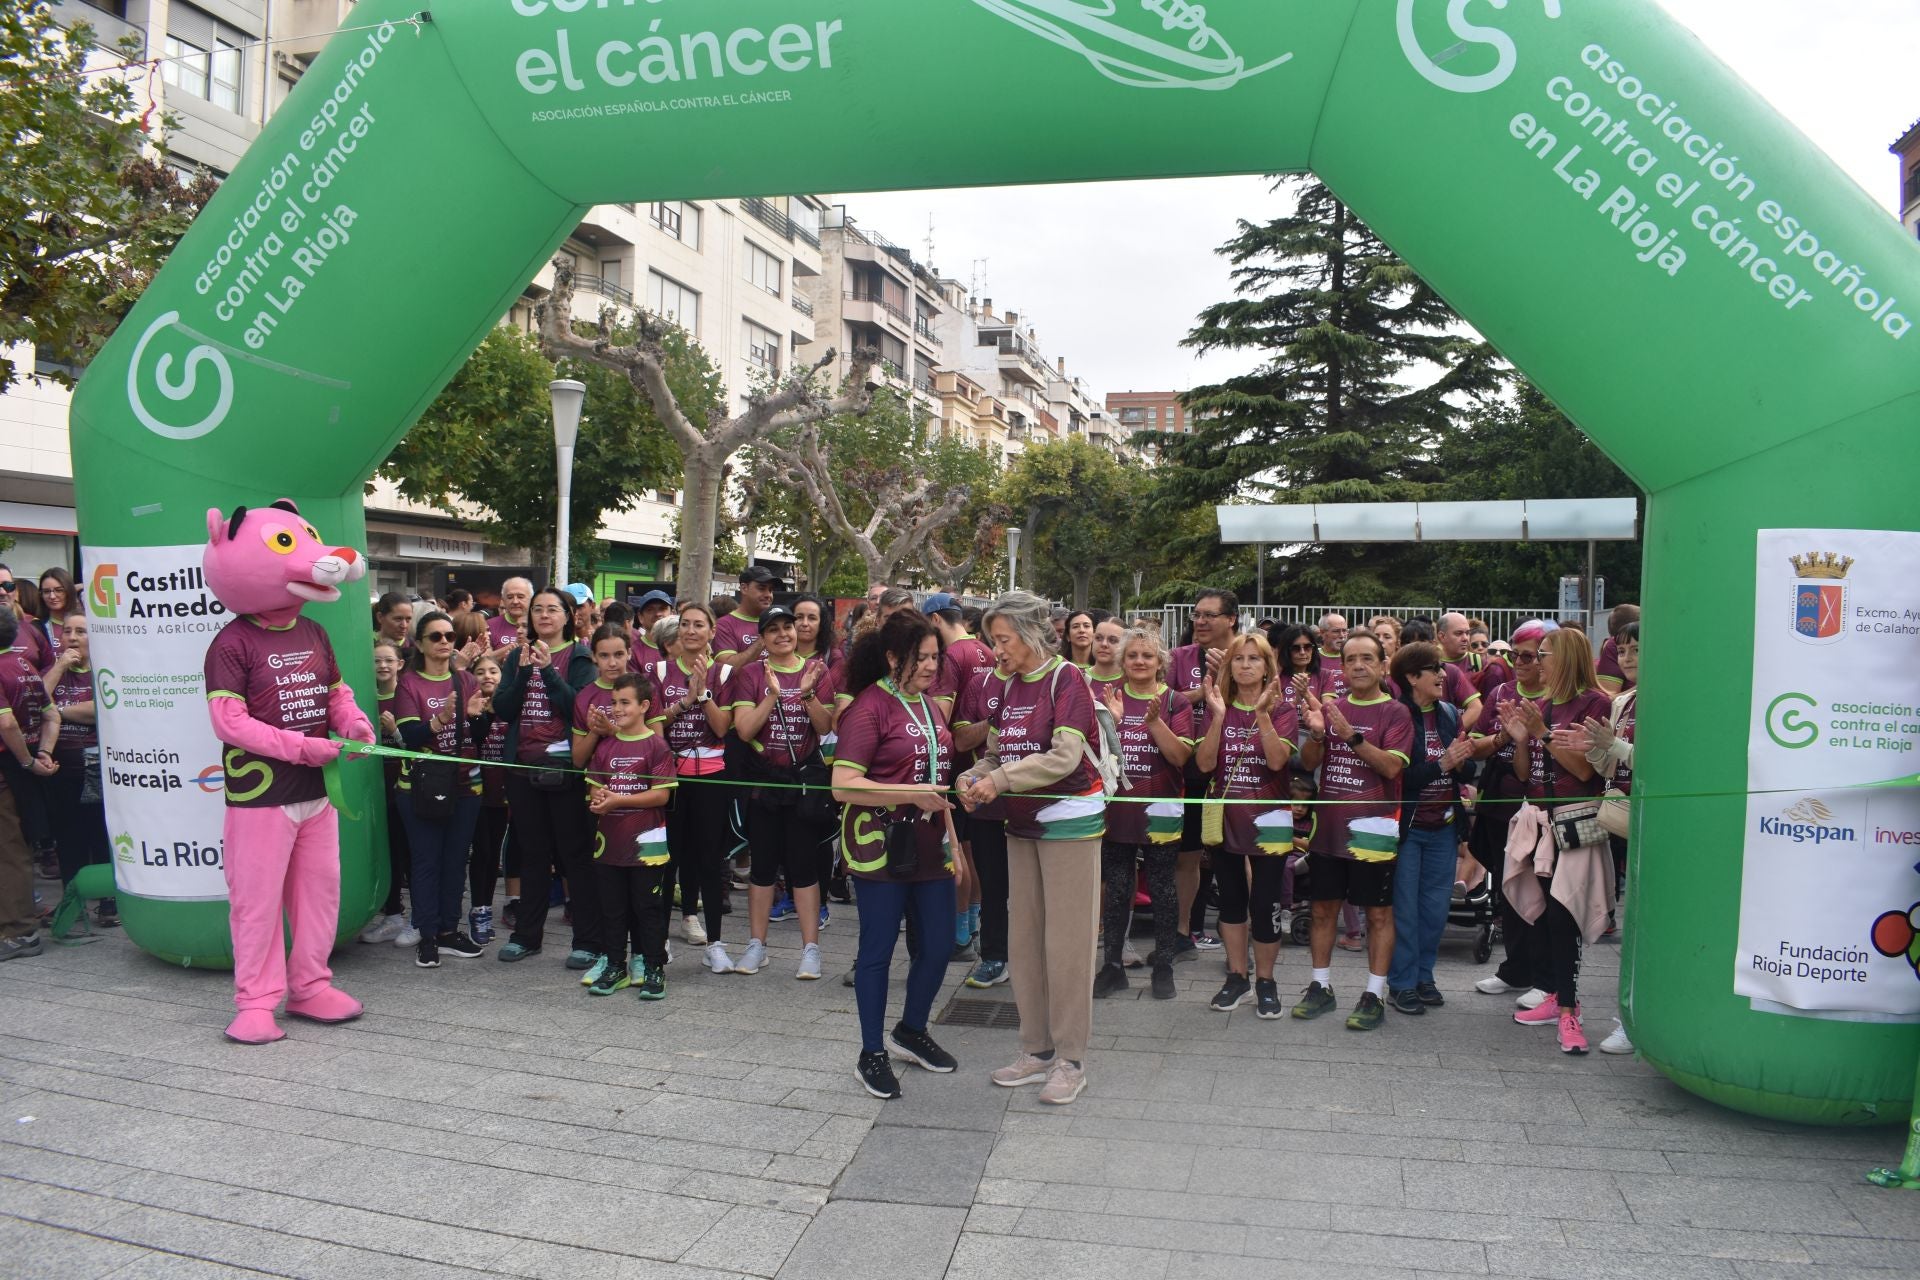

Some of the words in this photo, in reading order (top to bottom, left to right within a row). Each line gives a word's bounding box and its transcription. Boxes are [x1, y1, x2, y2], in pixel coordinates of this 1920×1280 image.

[516, 28, 585, 94] el
[596, 18, 843, 87] cáncer
[531, 104, 603, 122] ASOCIACIÓN
[605, 99, 669, 116] ESPAÑOLA
[669, 95, 722, 111] CONTRA
[723, 94, 739, 106] EL
[740, 90, 792, 105] CÁNCER
[195, 150, 302, 297] asociación
[299, 19, 396, 152] española
[1508, 111, 1559, 160] en
[1552, 145, 1602, 200] La
[1597, 184, 1688, 277] Rioja
[1545, 75, 1659, 178] contra
[1655, 171, 1702, 209] el
[1690, 203, 1814, 311] cáncer
[1581, 43, 1756, 201] asociación
[1756, 199, 1913, 341] española
[215, 225, 284, 322] contra
[279, 193, 308, 234] el
[301, 101, 379, 205] cáncer
[243, 309, 280, 351] en
[264, 253, 306, 316] La
[295, 203, 359, 278] Rioja
[127, 567, 209, 592] Castill
[130, 594, 226, 618] Arnedo
[1856, 606, 1901, 619] Excmo.
[91, 623, 147, 635] SUMINISTROS
[1855, 622, 1871, 633] de
[121, 672, 168, 683] asociación
[275, 676, 290, 685] La
[290, 671, 316, 683] Rioja
[122, 685, 151, 695] contra
[152, 686, 161, 695] el
[278, 690, 294, 700] En
[295, 684, 329, 697] marcha
[124, 700, 134, 708] en
[135, 699, 147, 708] La
[149, 699, 174, 709] Rioja
[280, 698, 316, 711] contra
[1831, 702, 1912, 716] asociación
[282, 711, 294, 722] el
[296, 707, 327, 720] cáncer
[1007, 726, 1027, 738] Rioja
[1831, 719, 1880, 732] contra
[1884, 719, 1897, 732] el
[1124, 731, 1148, 742] Rioja
[914, 744, 927, 755] La
[1006, 741, 1041, 751] marcha
[1122, 743, 1160, 754] marcha
[1225, 743, 1238, 752] La
[1830, 736, 1848, 747] en
[1853, 735, 1872, 749] La
[1877, 737, 1912, 753] Rioja
[106, 747, 180, 764] Fundación
[914, 759, 926, 770] En
[108, 767, 182, 792] Ibercaja
[1231, 774, 1262, 783] cáncer
[1331, 774, 1365, 787] cáncer
[617, 782, 648, 791] marcha
[1759, 816, 1855, 844] Kingspan
[141, 841, 168, 867] La
[1780, 941, 1869, 963] Fundación
[1752, 954, 1792, 977] Rioja
[1797, 961, 1868, 983] Deporte
